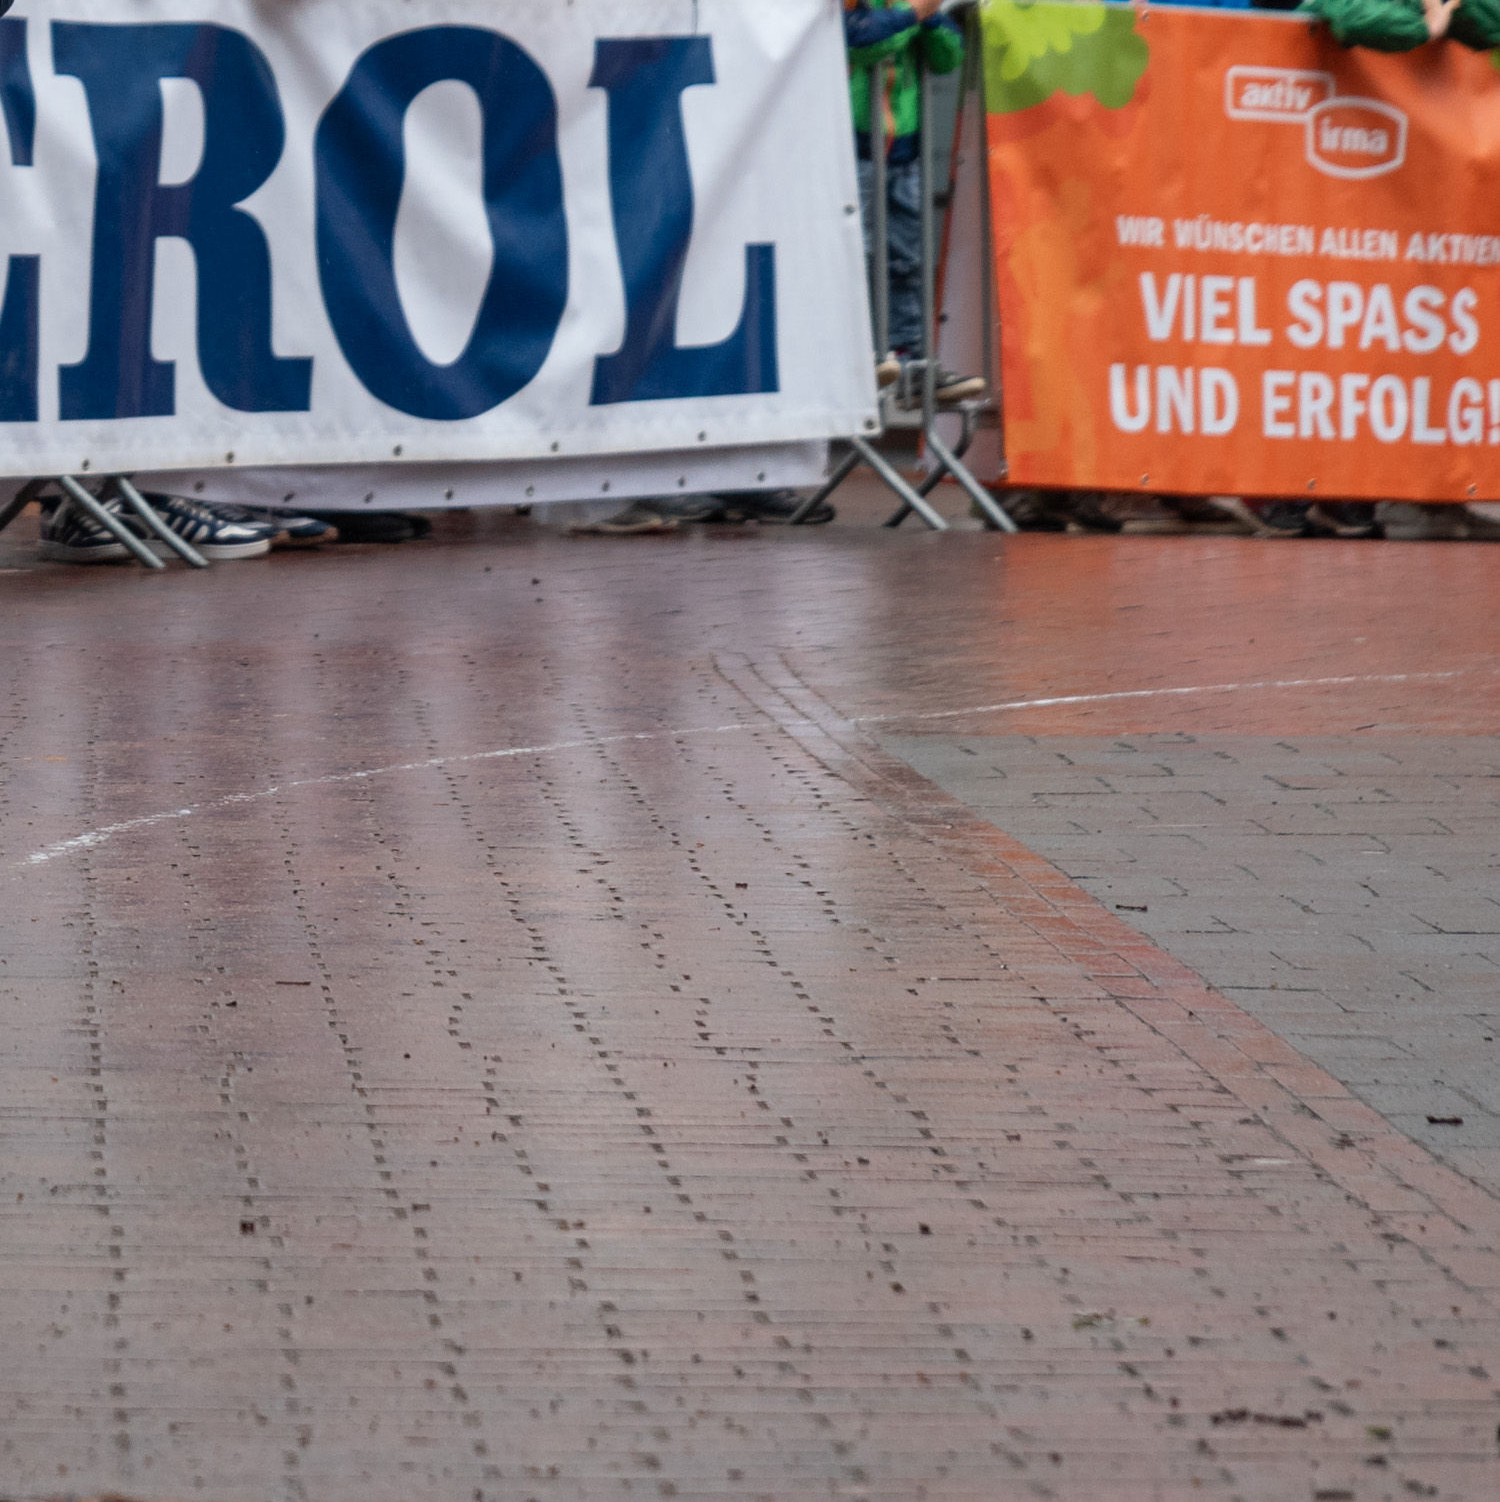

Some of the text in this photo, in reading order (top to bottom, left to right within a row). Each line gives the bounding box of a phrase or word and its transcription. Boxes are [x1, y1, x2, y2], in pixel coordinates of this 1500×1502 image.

[1240, 74, 1313, 110] aktiv
[1320, 116, 1389, 155] irma
[1116, 214, 1164, 248] WIR
[1173, 214, 1315, 257] WÜNSCHEN
[1318, 227, 1398, 262] ALLEN
[1139, 272, 1481, 356] VIEL SPASS
[1107, 363, 1500, 447] UND ERFOLG!
